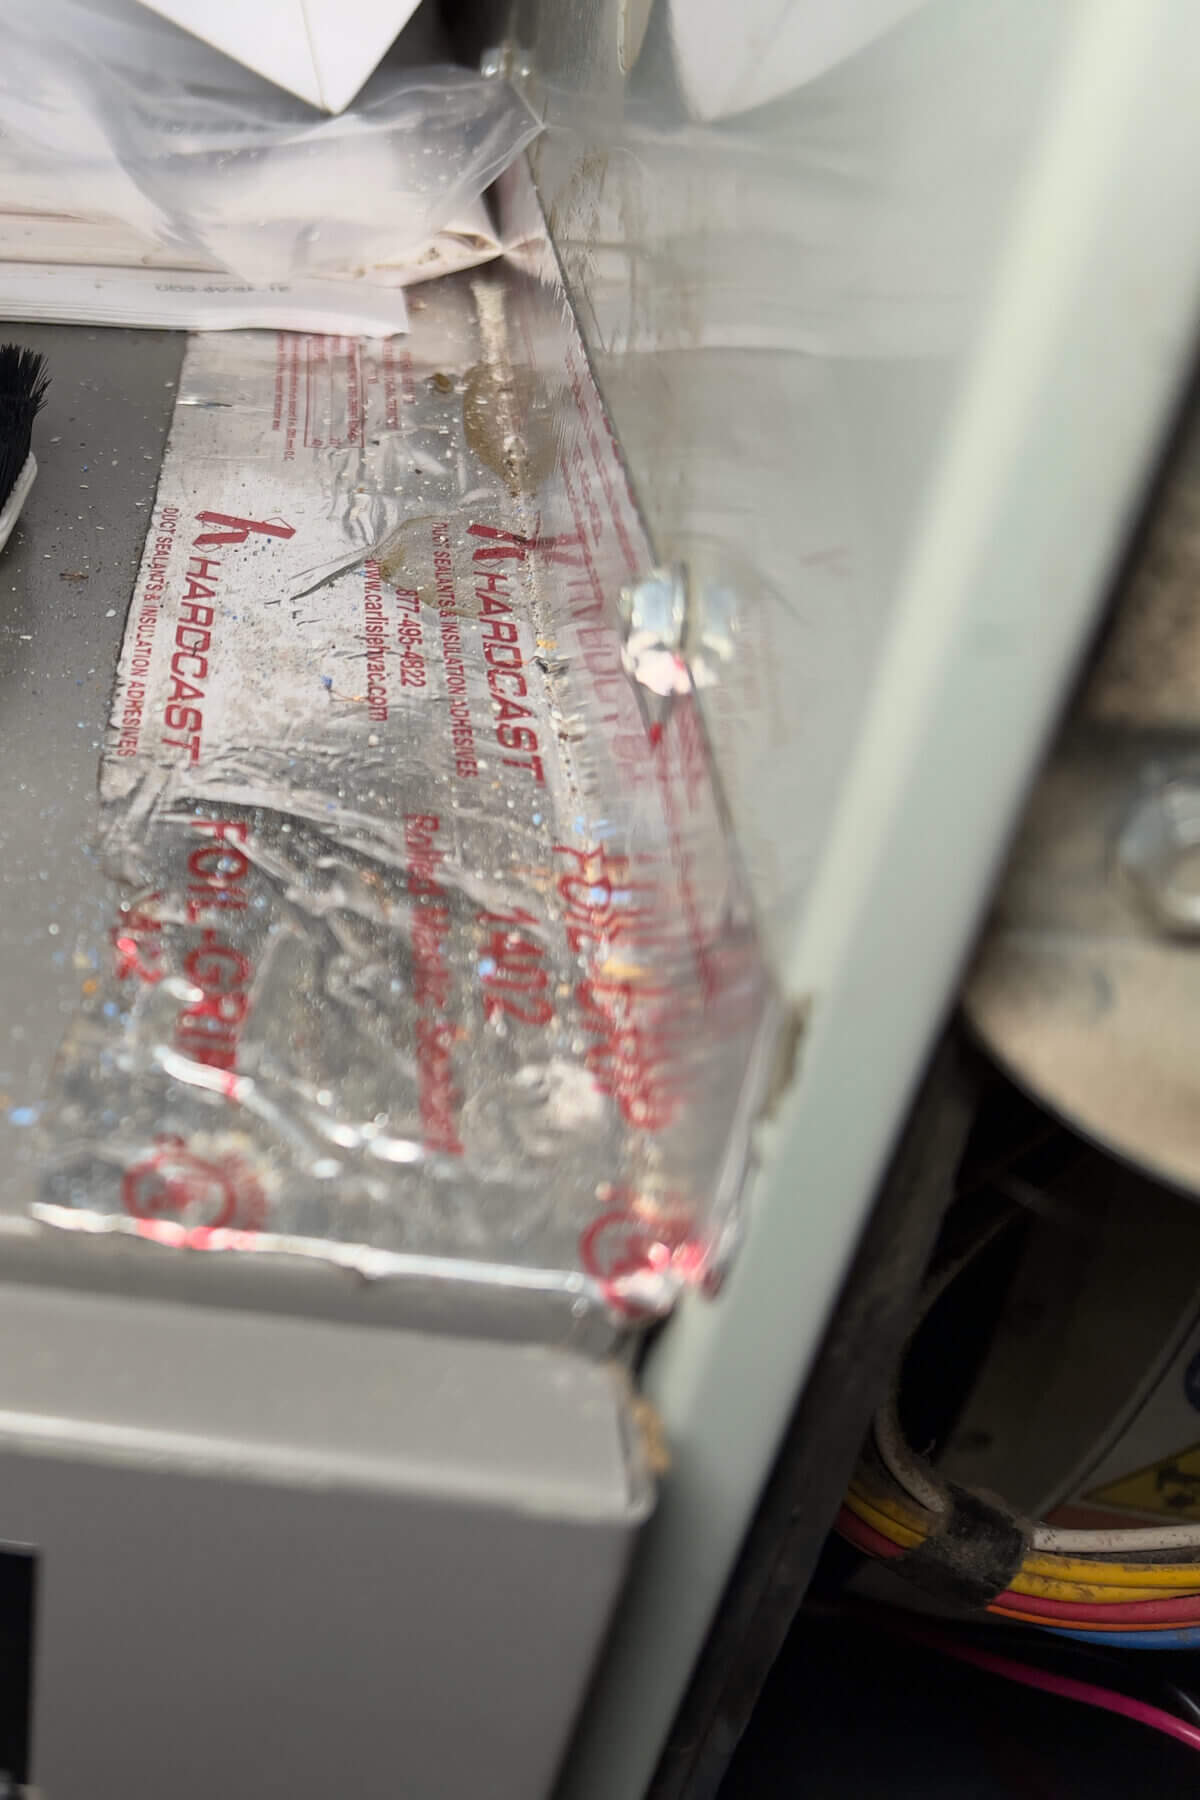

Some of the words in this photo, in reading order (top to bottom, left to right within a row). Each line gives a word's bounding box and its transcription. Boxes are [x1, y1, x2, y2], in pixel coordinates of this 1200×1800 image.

[163, 507, 179, 536] DUCT
[143, 593, 161, 601] &
[146, 536, 173, 592] SEALANTS
[434, 550, 455, 607] SEALANTS
[130, 605, 158, 676] INSULATION
[363, 559, 389, 722] www.carlislehvac.com
[396, 589, 426, 688] 877-495-4822
[439, 607, 457, 618] &
[161, 556, 221, 762] HARDCAST
[440, 621, 467, 695] INSULATION
[473, 571, 546, 788] HARDCAST
[117, 681, 147, 757] ADHESIVES
[450, 699, 479, 779] ADHESIVES
[477, 906, 554, 1027] 1402
